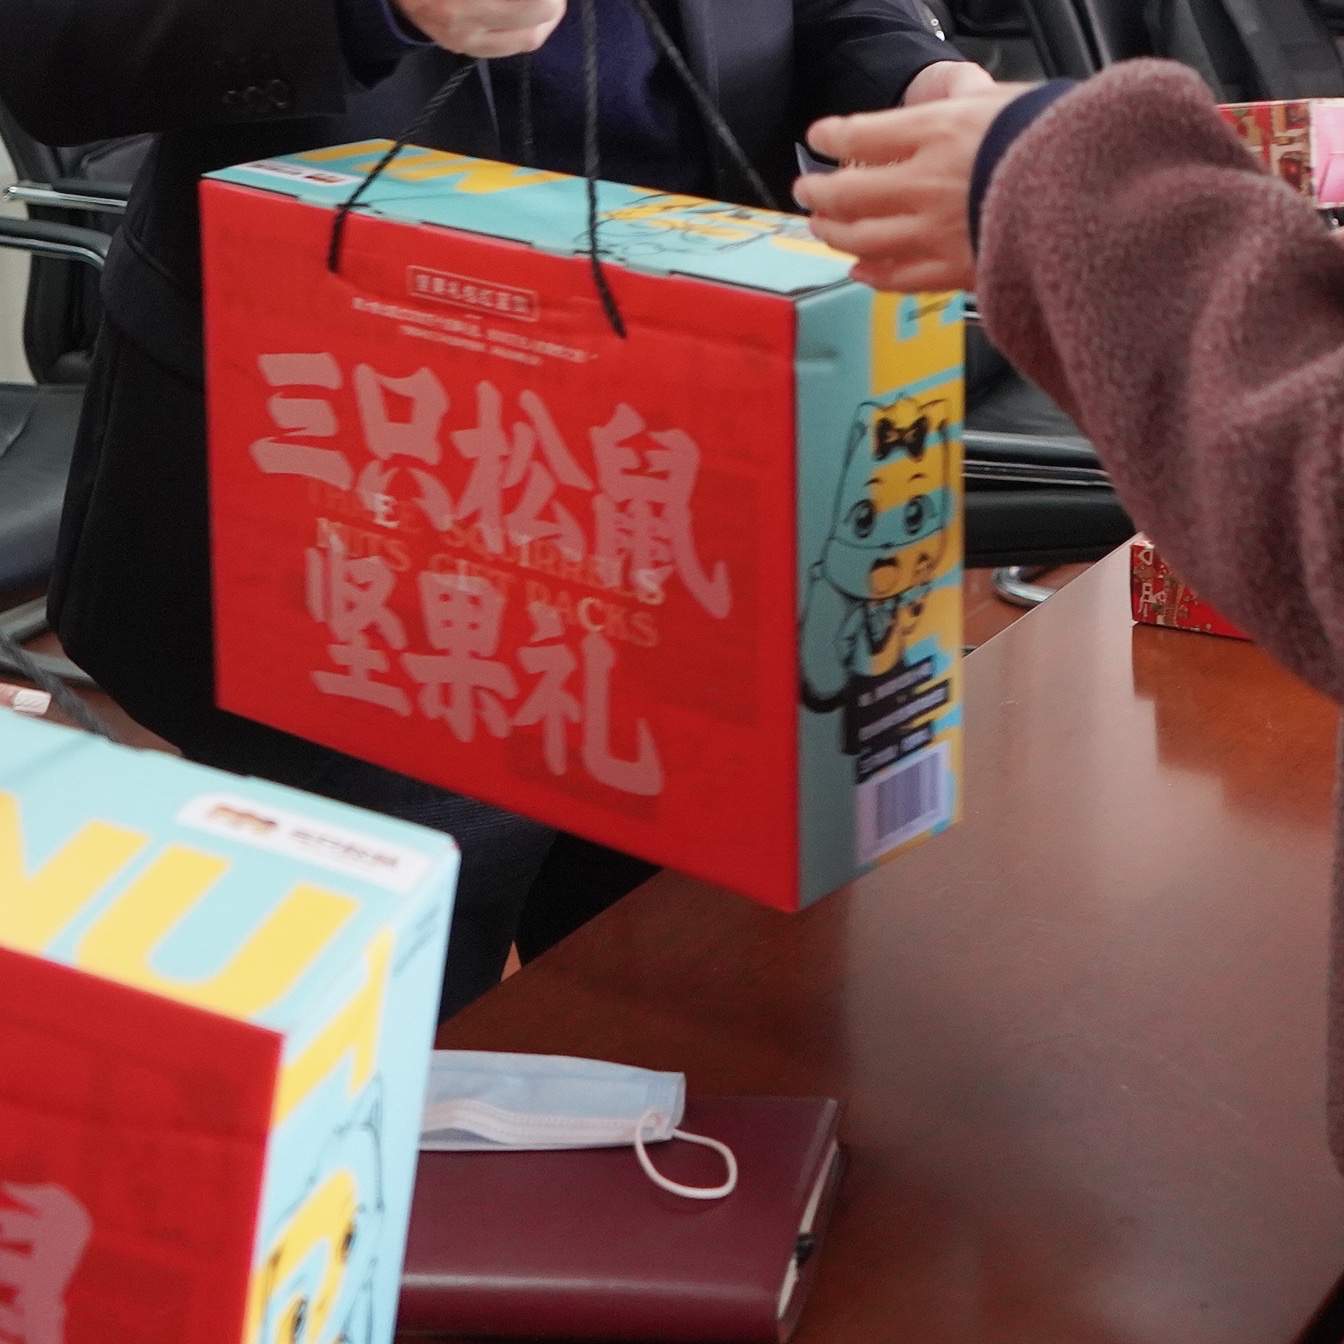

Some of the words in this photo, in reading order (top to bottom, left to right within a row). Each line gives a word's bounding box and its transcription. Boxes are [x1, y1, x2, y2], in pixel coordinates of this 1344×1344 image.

[249, 351, 733, 620] 三只松鼠
[304, 531, 665, 796] 坚果礼
